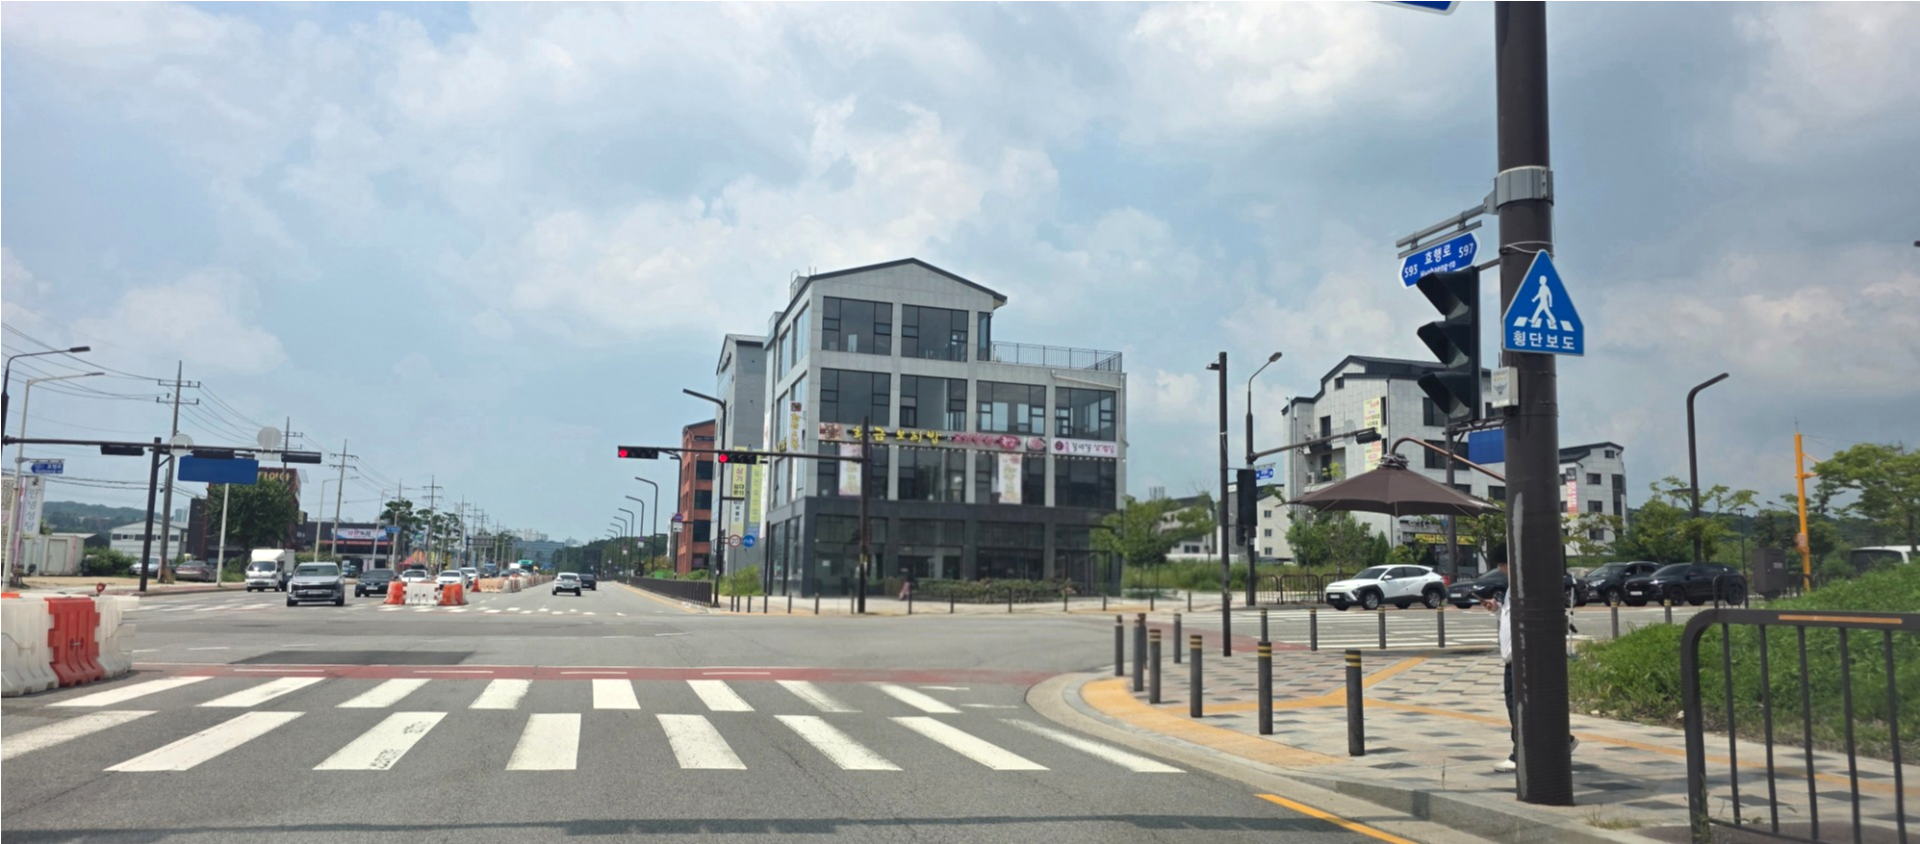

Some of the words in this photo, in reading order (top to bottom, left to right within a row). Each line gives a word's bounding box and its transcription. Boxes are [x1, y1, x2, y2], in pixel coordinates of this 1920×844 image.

[1404, 264, 1418, 278] 593
[1424, 244, 1452, 265] 효행로
[1458, 243, 1474, 258] 597
[1513, 330, 1576, 351] 횡단보도
[896, 428, 942, 445] 보리밥
[731, 537, 739, 545] 20
